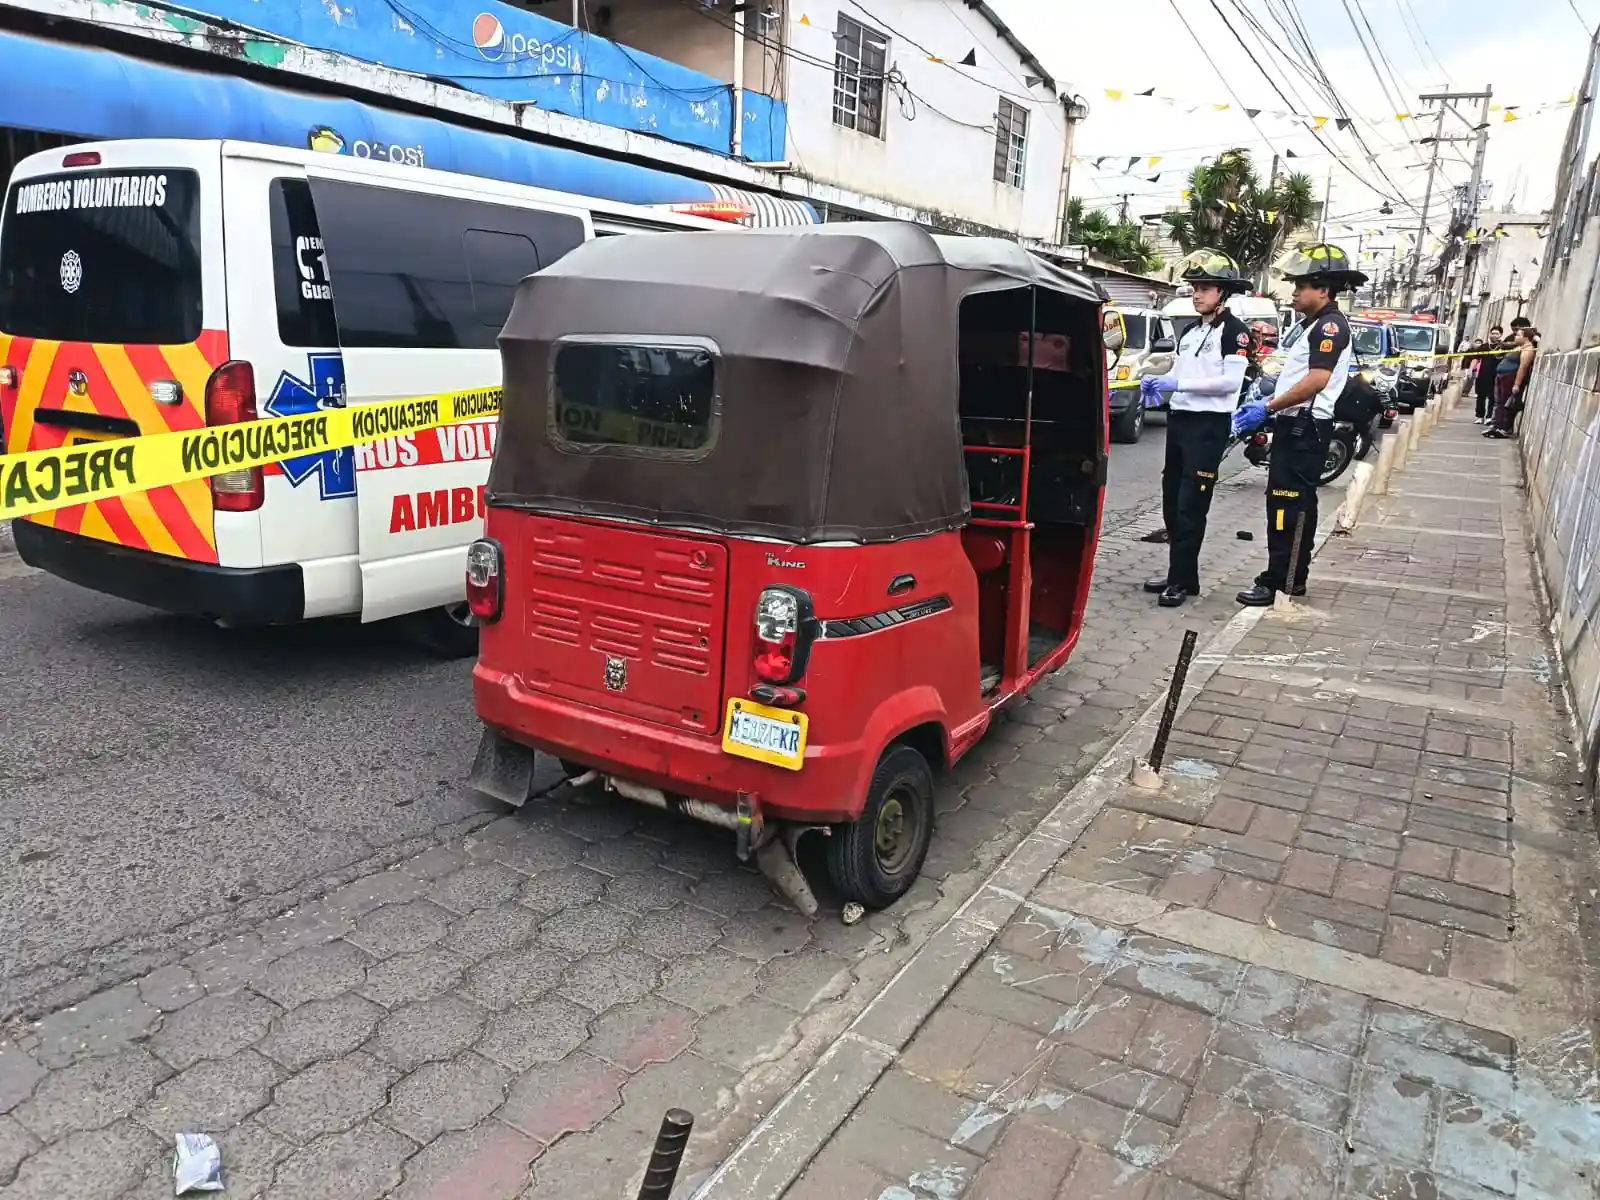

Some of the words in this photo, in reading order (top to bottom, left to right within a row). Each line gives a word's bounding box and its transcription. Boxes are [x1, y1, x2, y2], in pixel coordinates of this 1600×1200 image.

[512, 33, 572, 73] pepsi
[16, 180, 72, 214] BOMBEROS
[73, 174, 167, 209] VOLUNTARIOS
